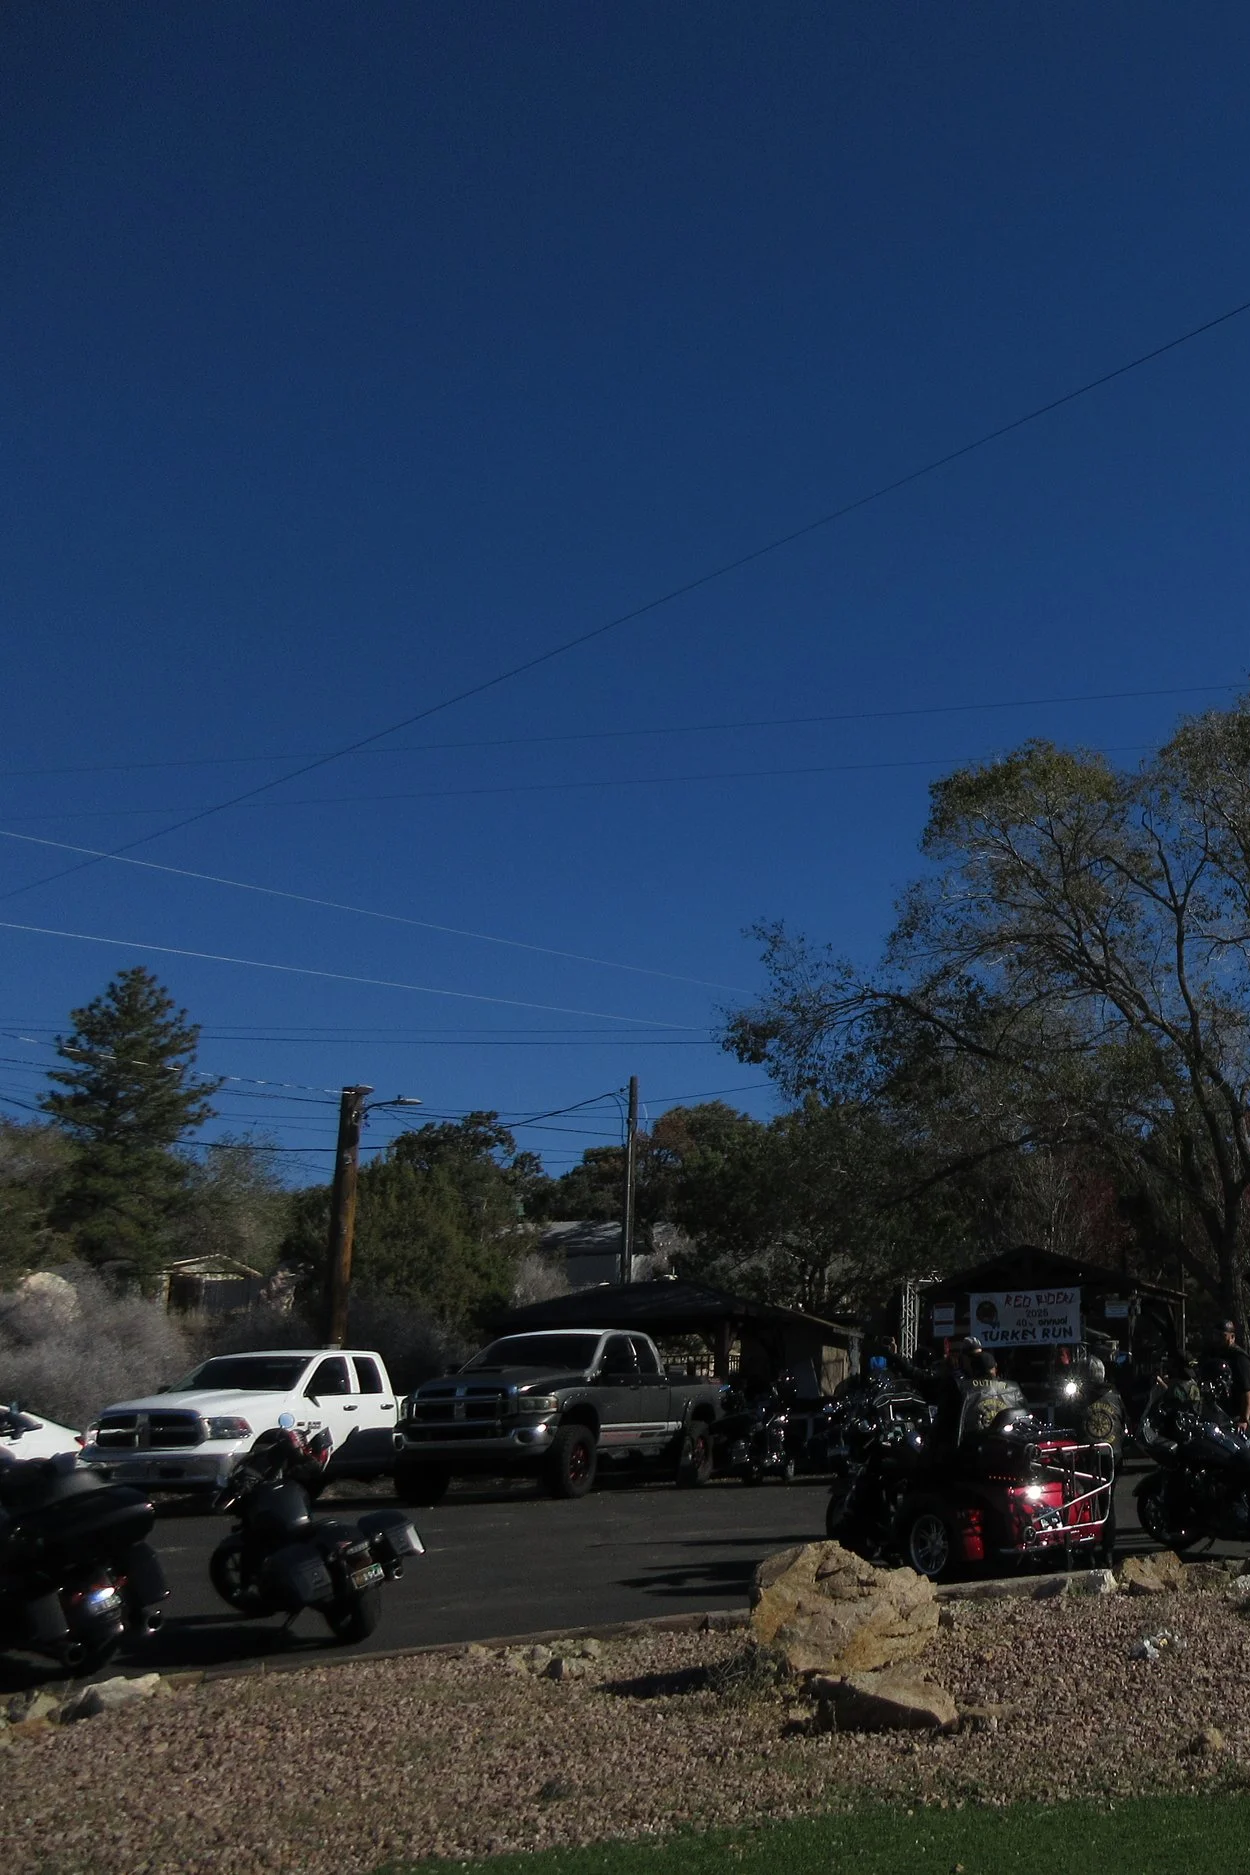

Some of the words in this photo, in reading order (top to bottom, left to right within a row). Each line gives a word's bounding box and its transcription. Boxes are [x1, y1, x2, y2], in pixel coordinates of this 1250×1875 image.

[1005, 1294, 1032, 1308] RED
[1025, 1308, 1049, 1318] 2025
[981, 1327, 1037, 1342] TURKEY
[1042, 1326, 1073, 1340] RUN
